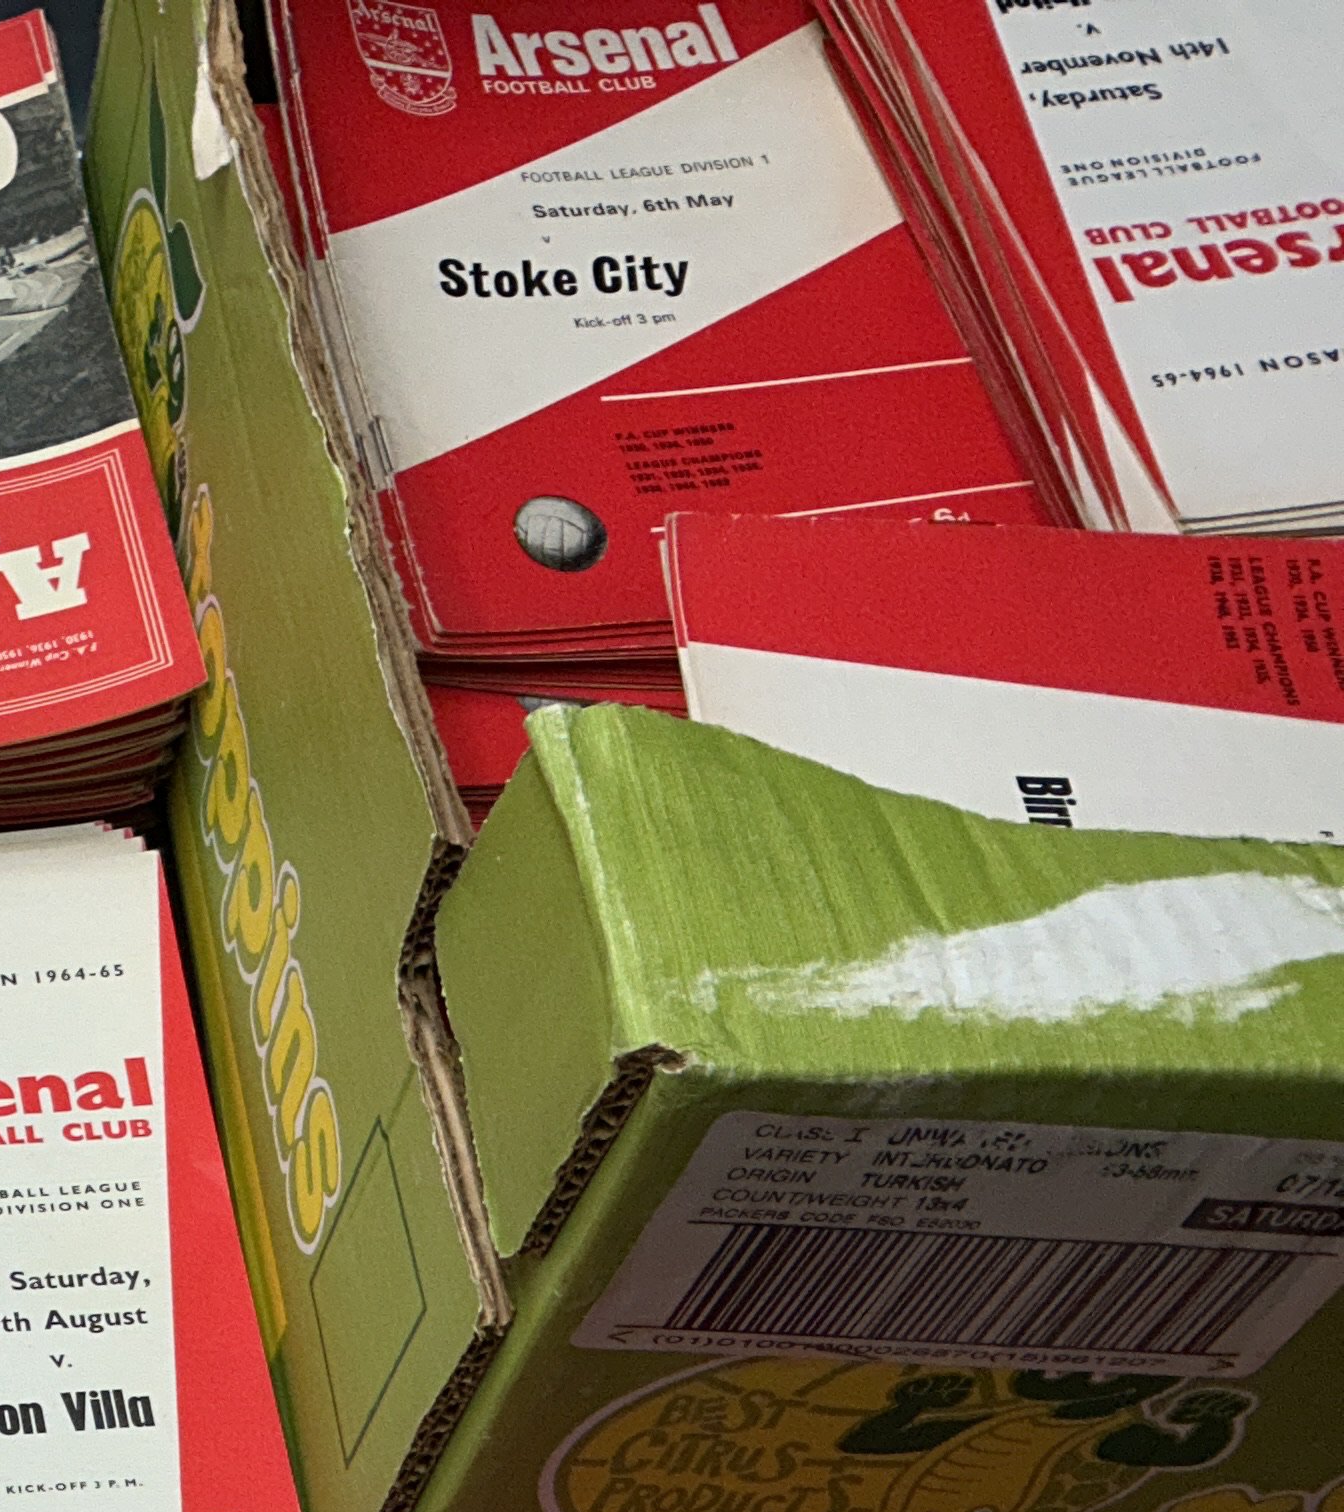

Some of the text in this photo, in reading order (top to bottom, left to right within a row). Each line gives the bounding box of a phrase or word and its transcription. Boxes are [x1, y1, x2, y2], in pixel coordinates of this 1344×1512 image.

[470, 3, 740, 80] Arsenal
[1020, 37, 1231, 75] 14th November
[482, 75, 657, 96] FOOTBALL CLUB
[1029, 82, 1164, 109] Saturday,
[609, 155, 754, 180] LEAGUE DIVISION
[531, 192, 735, 221] Saturday, 6th May
[1084, 220, 1172, 246] CLUB
[438, 254, 690, 300] Stoke City
[1150, 362, 1242, 389] 1964-65
[33, 963, 126, 986] 1964-65
[61, 1117, 153, 1141] CLUB
[744, 1146, 848, 1166] VARIETY
[725, 1168, 968, 1193] ORIGIN TURKISH
[9, 1266, 152, 1292] Saturday,
[44, 1305, 149, 1334] August
[60, 1388, 156, 1433] Villa
